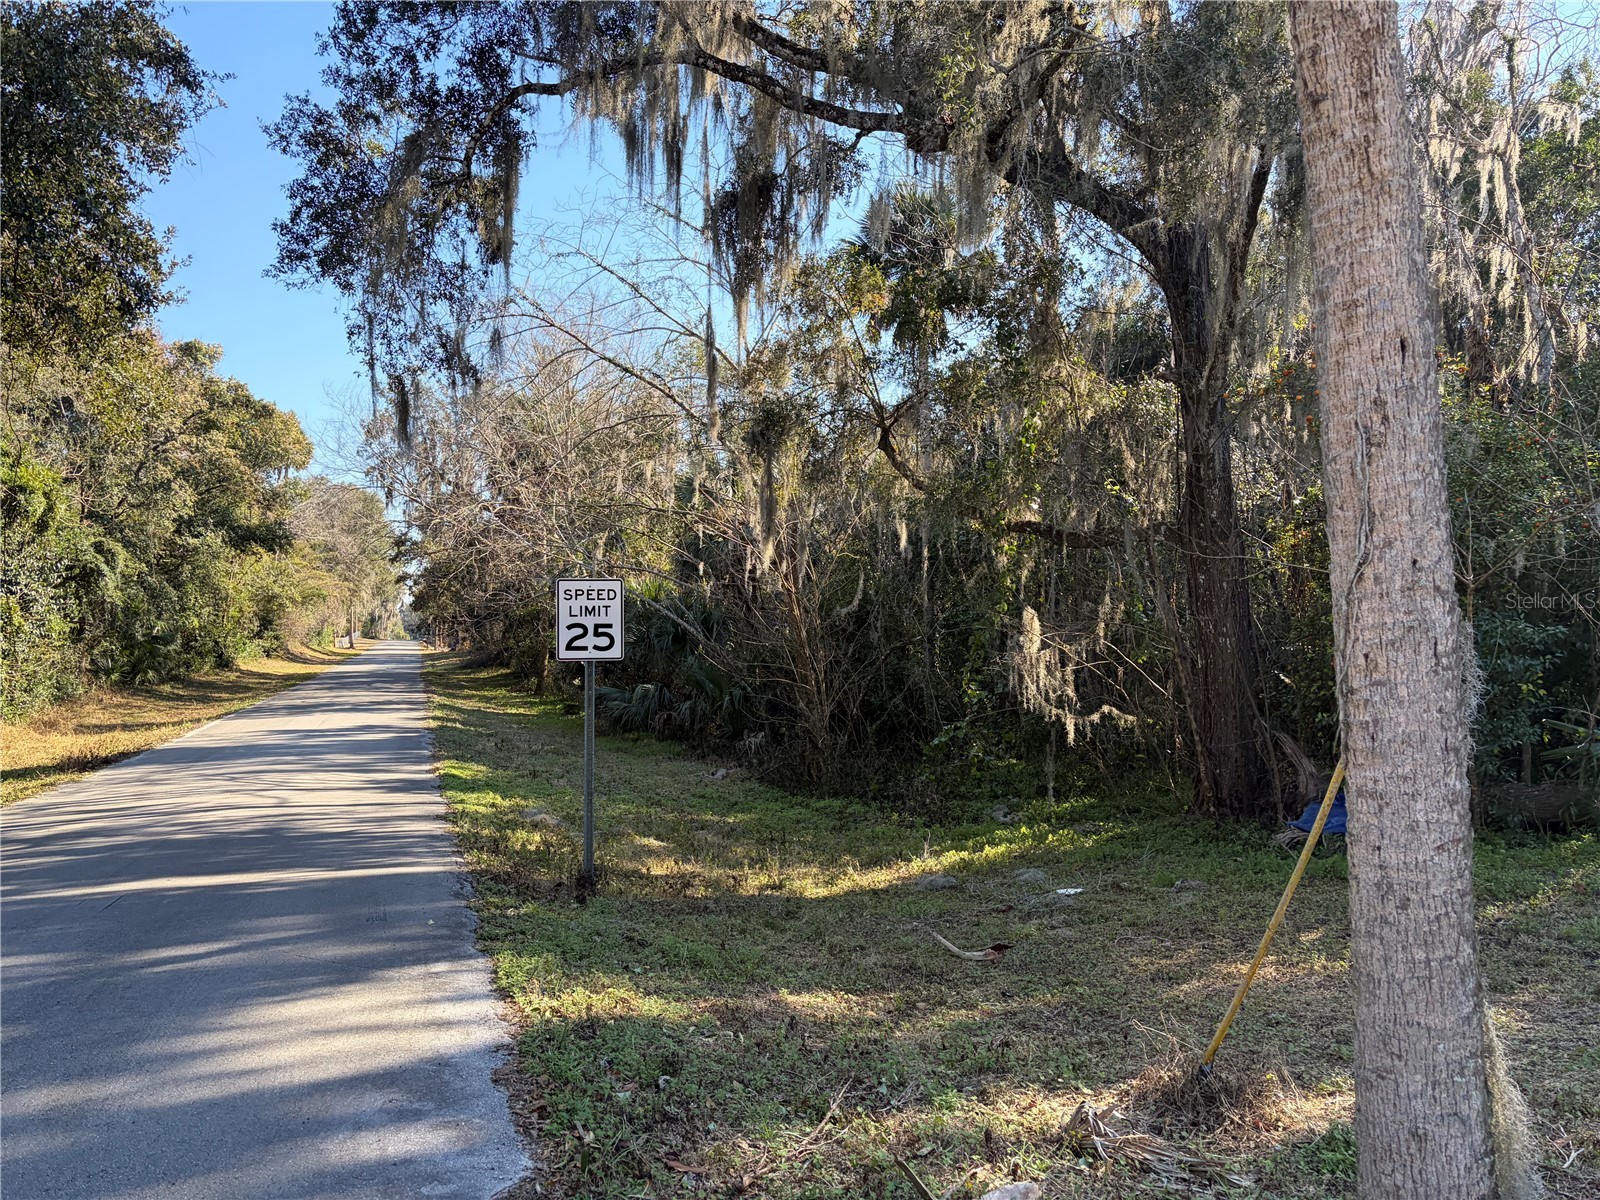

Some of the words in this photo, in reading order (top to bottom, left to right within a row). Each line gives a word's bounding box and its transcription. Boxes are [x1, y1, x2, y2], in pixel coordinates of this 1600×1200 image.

[563, 588, 617, 601] SPEED
[569, 605, 611, 617] LIMIT
[564, 622, 615, 652] 25
